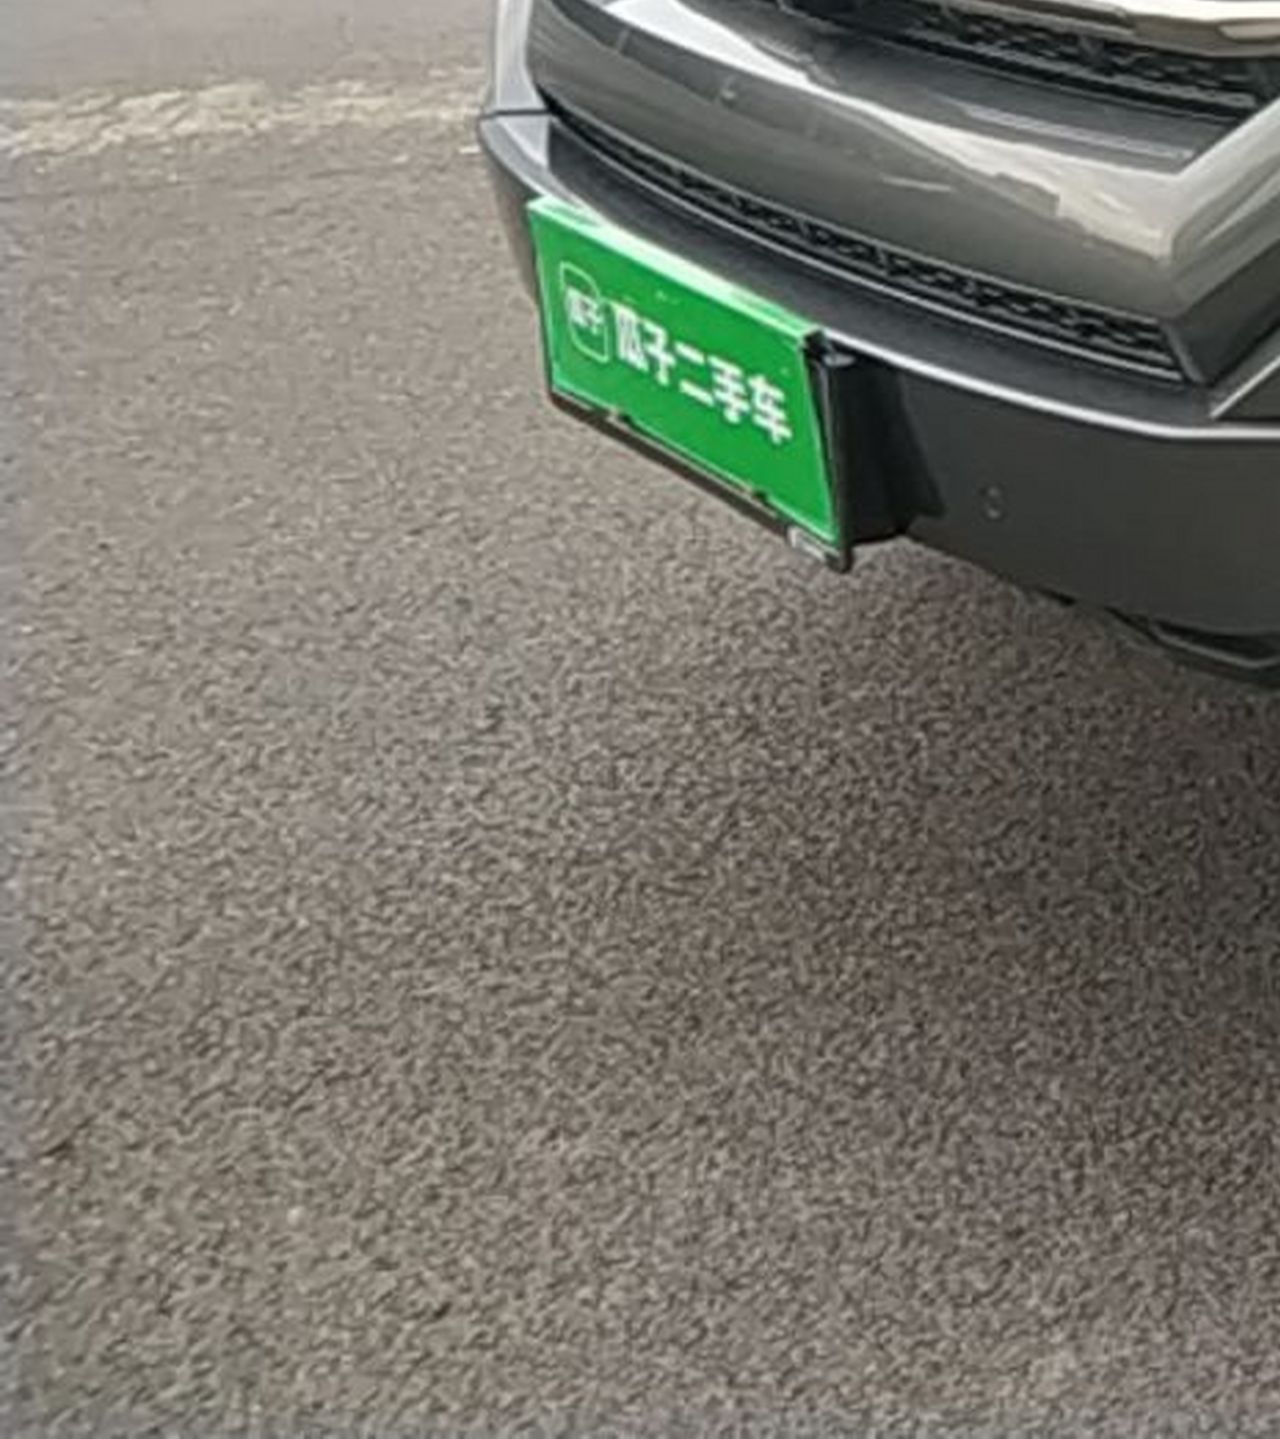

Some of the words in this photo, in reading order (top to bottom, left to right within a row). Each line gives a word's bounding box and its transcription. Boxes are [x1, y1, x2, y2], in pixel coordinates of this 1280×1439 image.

[610, 298, 793, 446] 瓜子二手车
